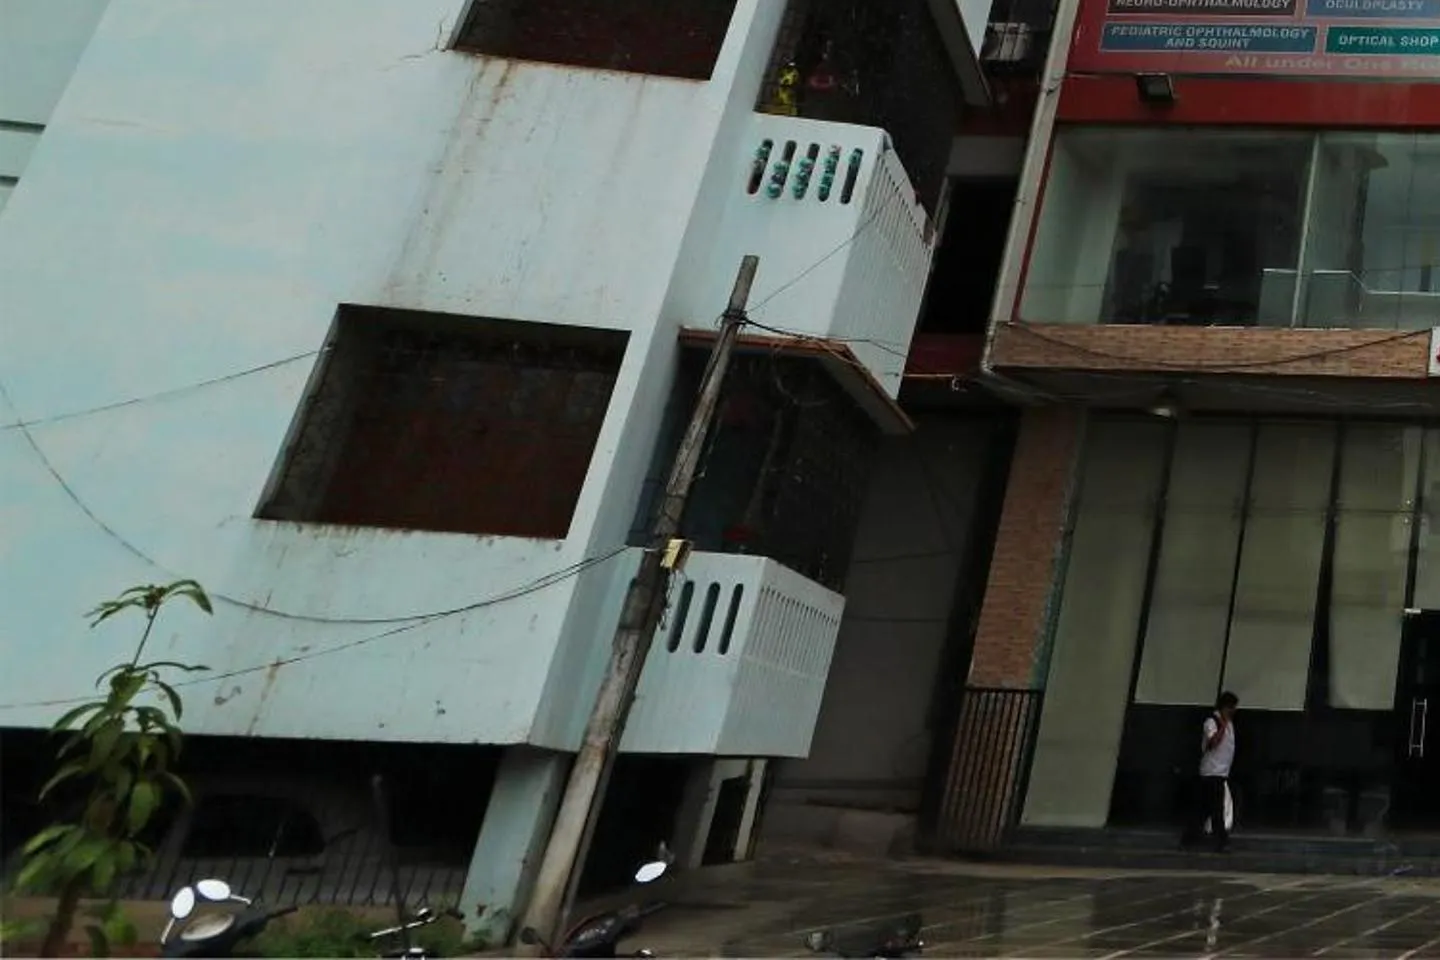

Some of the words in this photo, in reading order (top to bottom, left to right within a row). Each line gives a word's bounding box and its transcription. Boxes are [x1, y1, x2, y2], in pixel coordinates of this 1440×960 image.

[1111, 25, 1182, 37] PEDIATRIC
[1185, 26, 1311, 40] OPHTHALMOLOGY
[1164, 38, 1195, 48] AND
[1198, 38, 1250, 49] SQUINT
[1338, 34, 1395, 47] OPTICAL
[1399, 36, 1440, 48] SHOP
